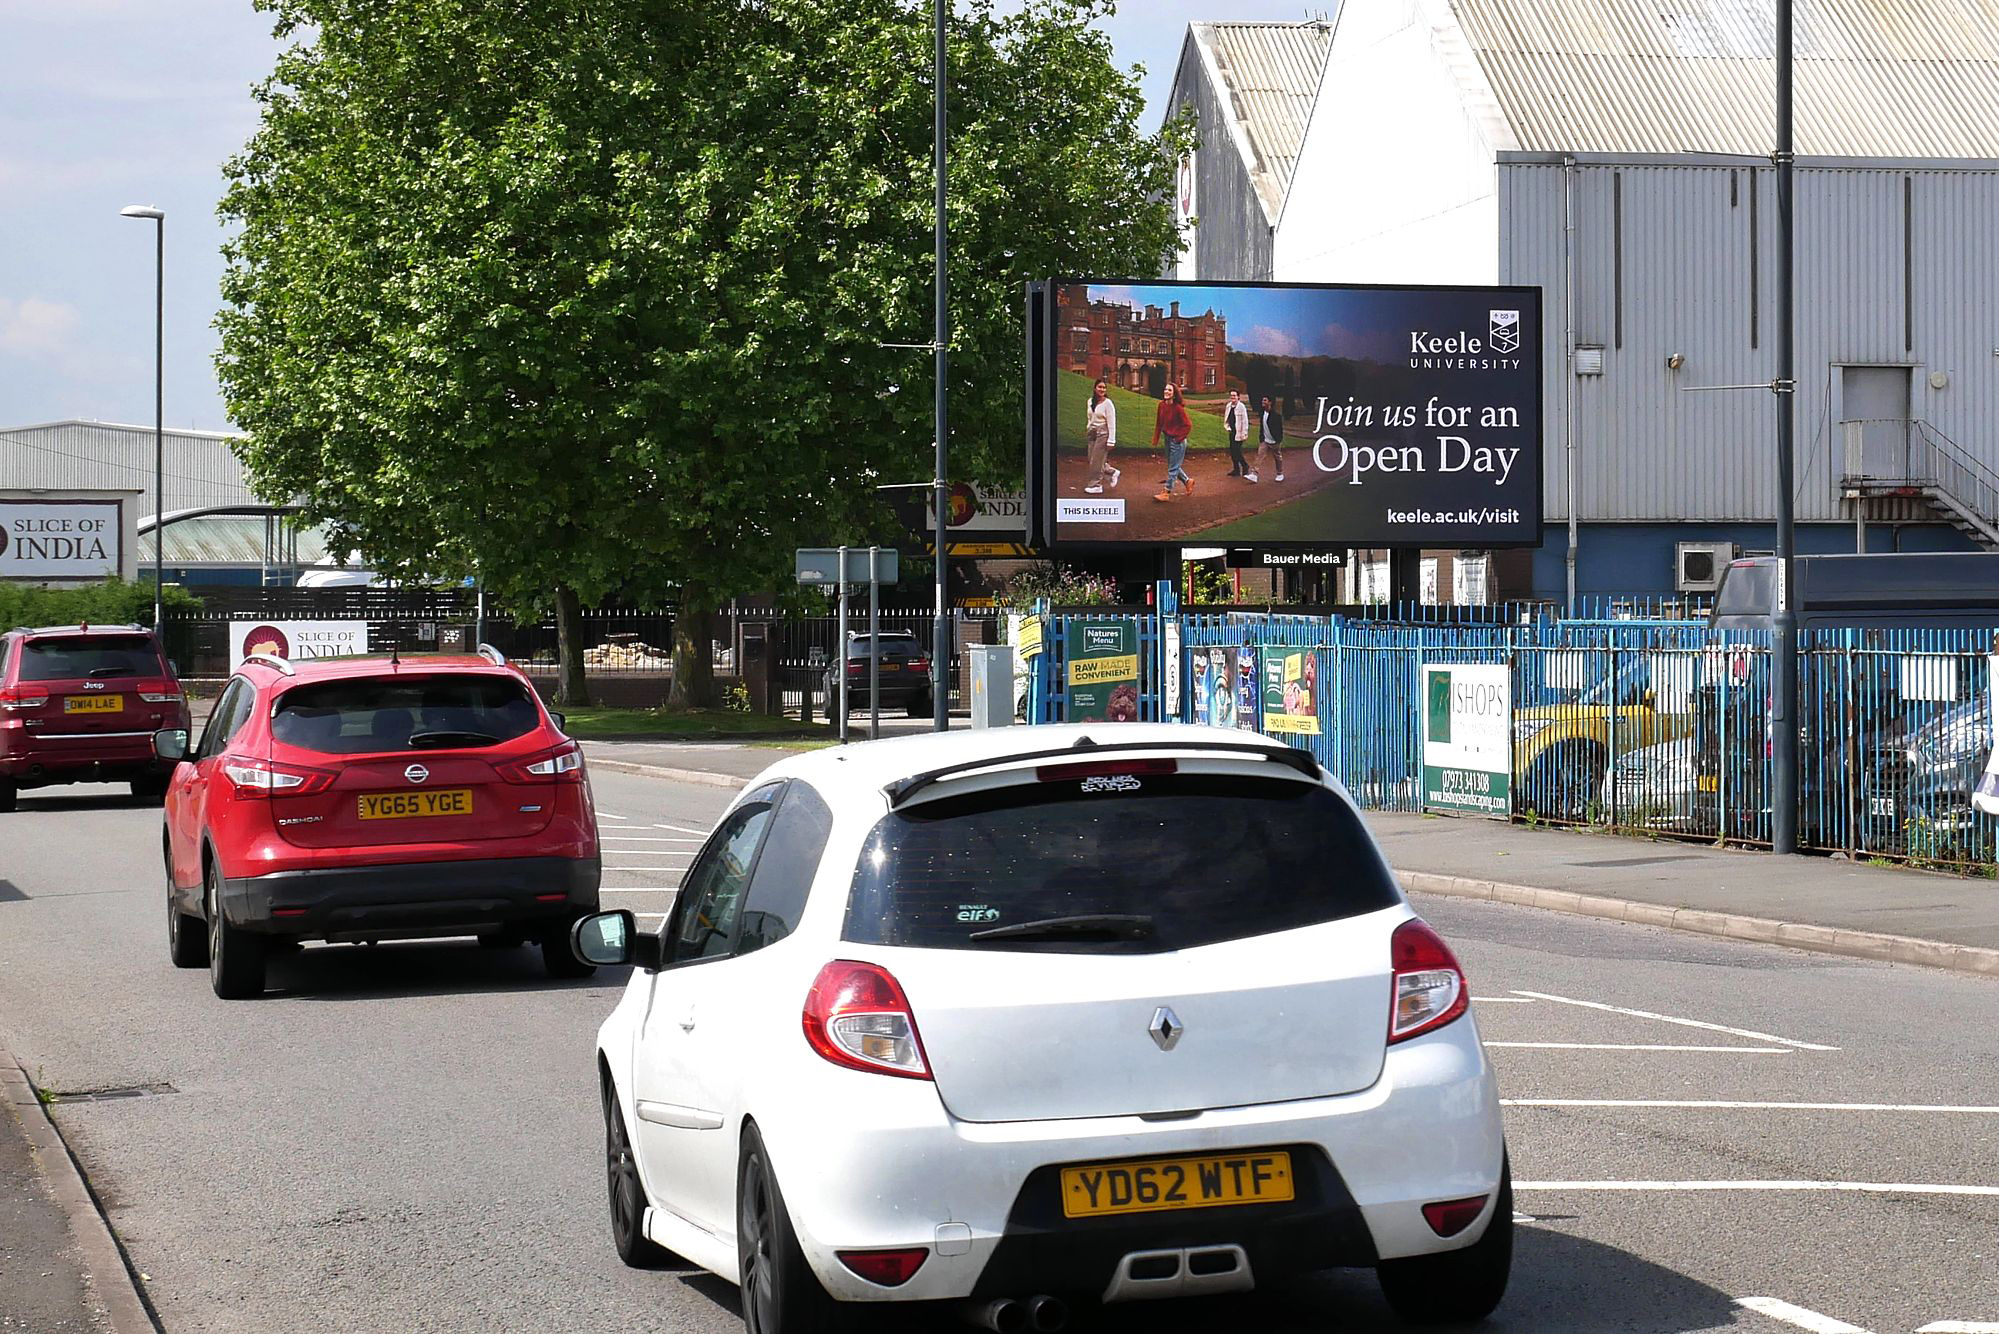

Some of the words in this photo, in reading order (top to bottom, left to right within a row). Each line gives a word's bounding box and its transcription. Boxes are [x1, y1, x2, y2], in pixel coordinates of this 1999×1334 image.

[1411, 331, 1482, 354] Keele
[1410, 358, 1520, 370] UNIVERSITY
[1313, 396, 1374, 434] Join
[1383, 405, 1416, 427] us
[1425, 396, 1472, 427] for
[1480, 405, 1520, 428] an
[1312, 434, 1426, 485] Open
[1436, 435, 1520, 486] Day
[1063, 507, 1081, 515] THIS
[1083, 507, 1090, 515] IS
[1091, 507, 1119, 515] KEELE
[1387, 508, 1520, 526] keele.ac.uk/visit
[14, 519, 72, 532] SLICE
[78, 519, 106, 532] OF
[14, 537, 107, 559] INDIA
[1263, 553, 1300, 564] Bauer
[1302, 552, 1341, 564] Media
[297, 631, 335, 641] SLICE
[337, 631, 356, 641] OF
[1087, 629, 1119, 638] Natures
[297, 643, 354, 659] INDIA
[1075, 662, 1098, 672] RAW
[1100, 659, 1130, 670] MADE
[1075, 668, 1130, 680] CONVENIENT
[95, 698, 116, 709] LAE
[1442, 769, 1463, 789] 07973
[1464, 771, 1489, 793] 341308
[366, 796, 420, 817] YG65
[425, 792, 465, 813] YGE
[957, 909, 985, 921] elf
[1079, 1165, 1188, 1209] YD62
[1197, 1157, 1273, 1200] WTF
